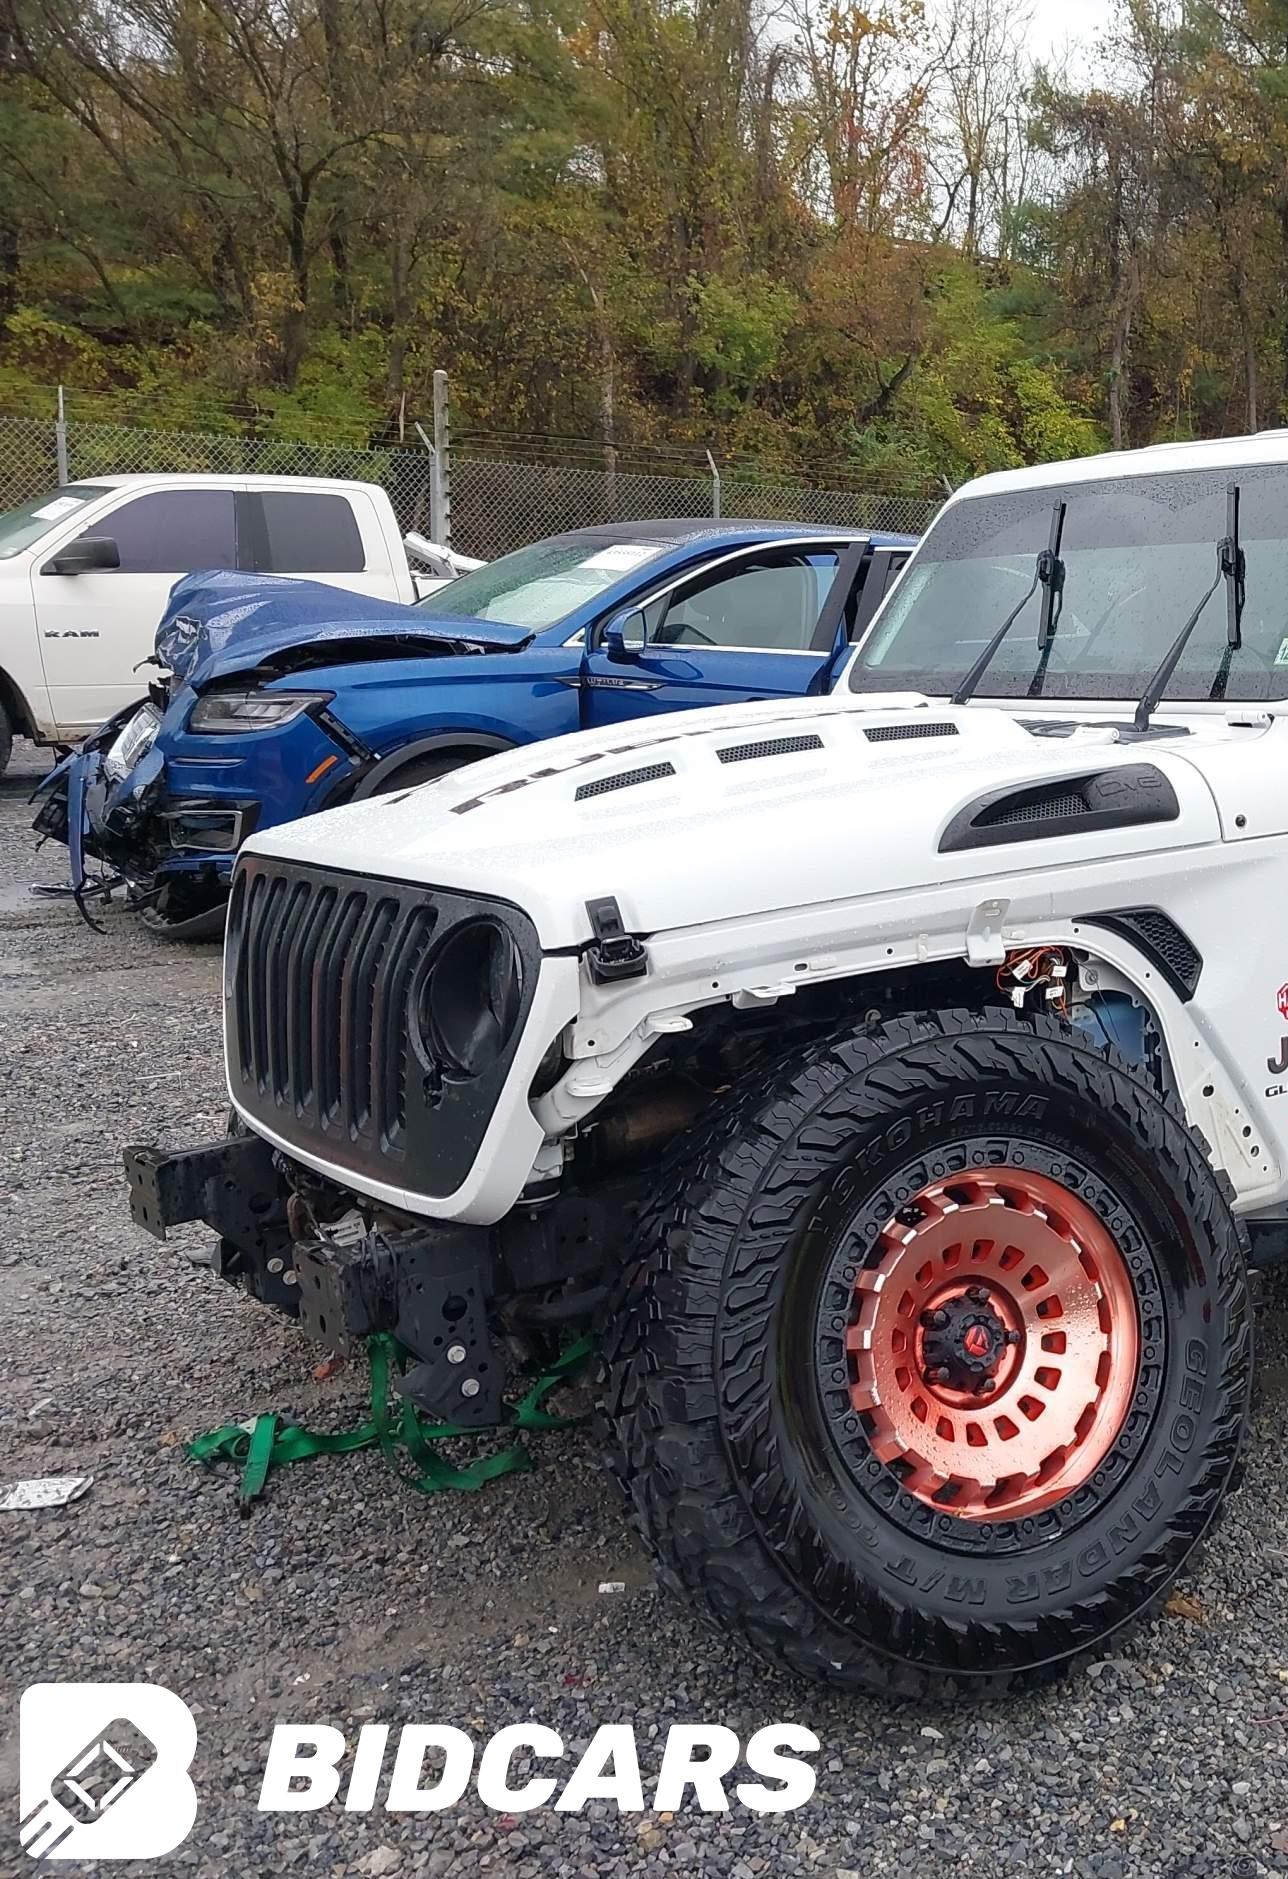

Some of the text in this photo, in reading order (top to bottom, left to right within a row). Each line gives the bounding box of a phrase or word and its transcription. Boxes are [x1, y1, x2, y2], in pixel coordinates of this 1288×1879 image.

[44, 630, 100, 639] RAM
[1006, 1337, 1208, 1604] GEOLANDAR
[883, 1554, 987, 1604] M/T
